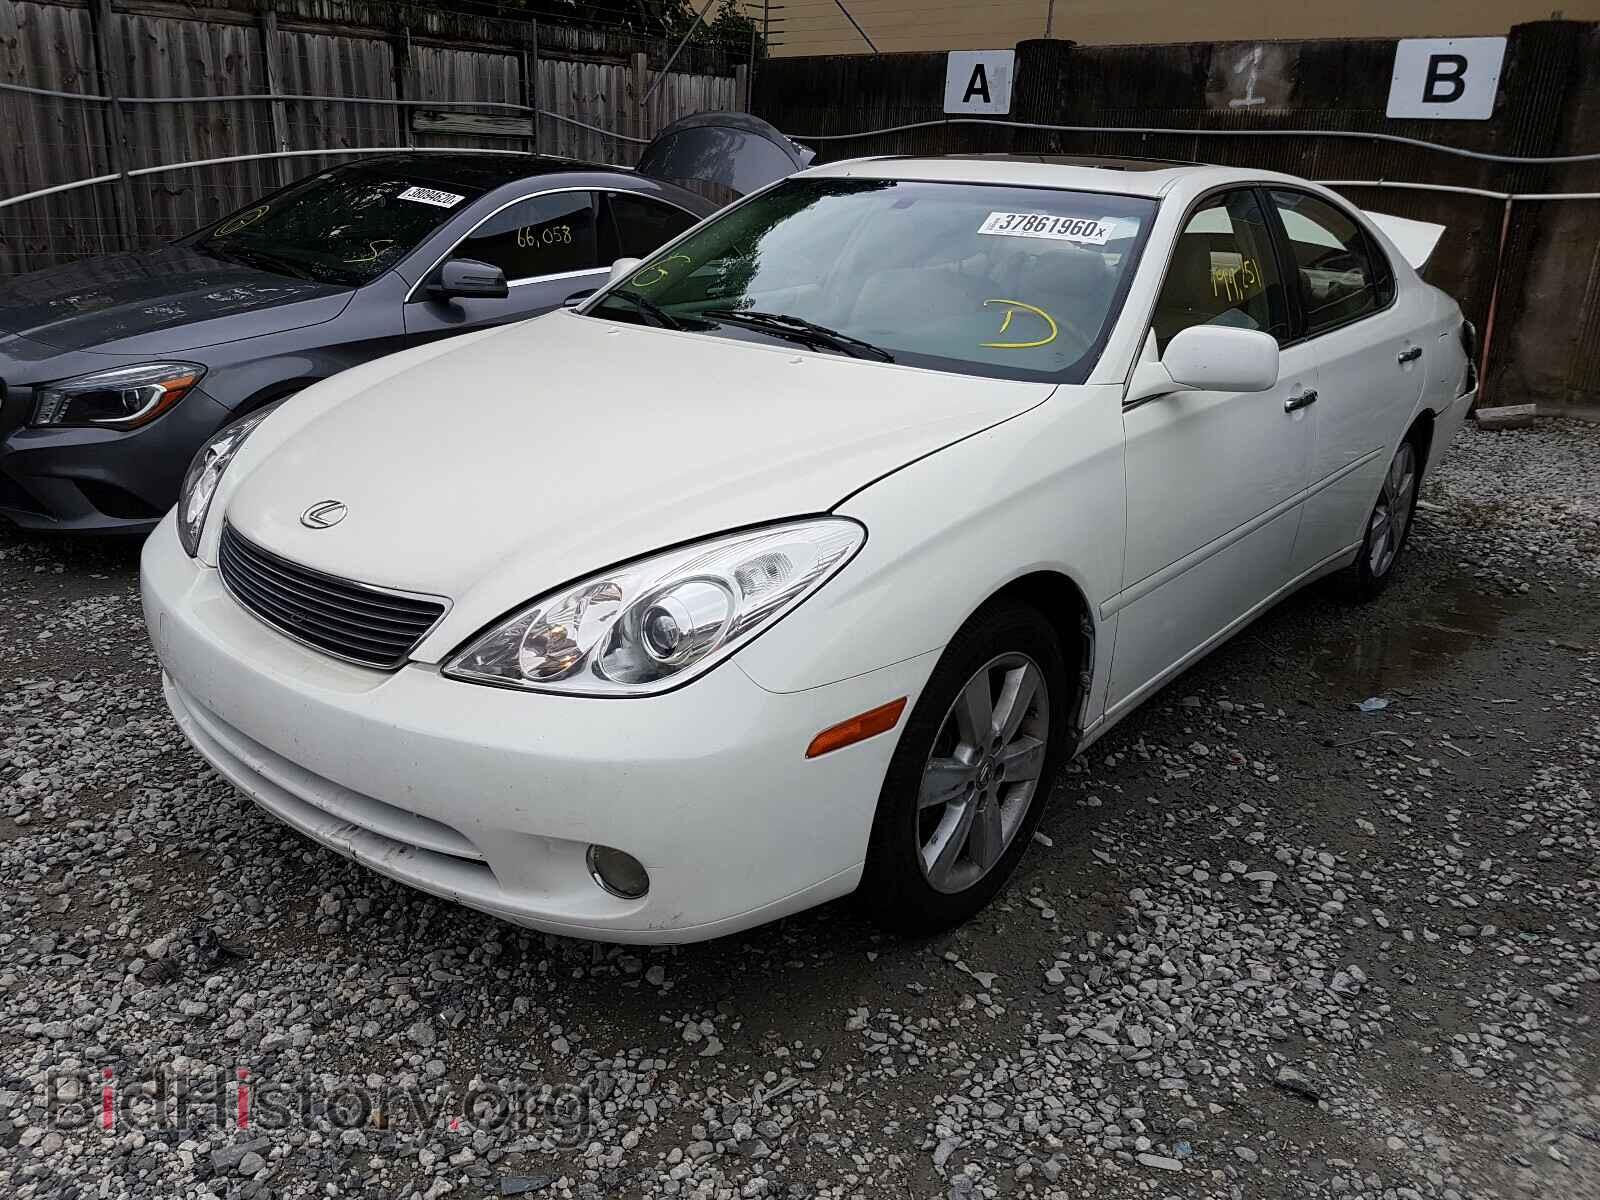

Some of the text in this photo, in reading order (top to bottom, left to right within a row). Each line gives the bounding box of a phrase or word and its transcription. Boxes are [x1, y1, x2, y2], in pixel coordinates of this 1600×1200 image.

[962, 64, 991, 103] A
[1422, 54, 1468, 103] B
[517, 225, 572, 248] 66,058
[978, 299, 1057, 349] D
